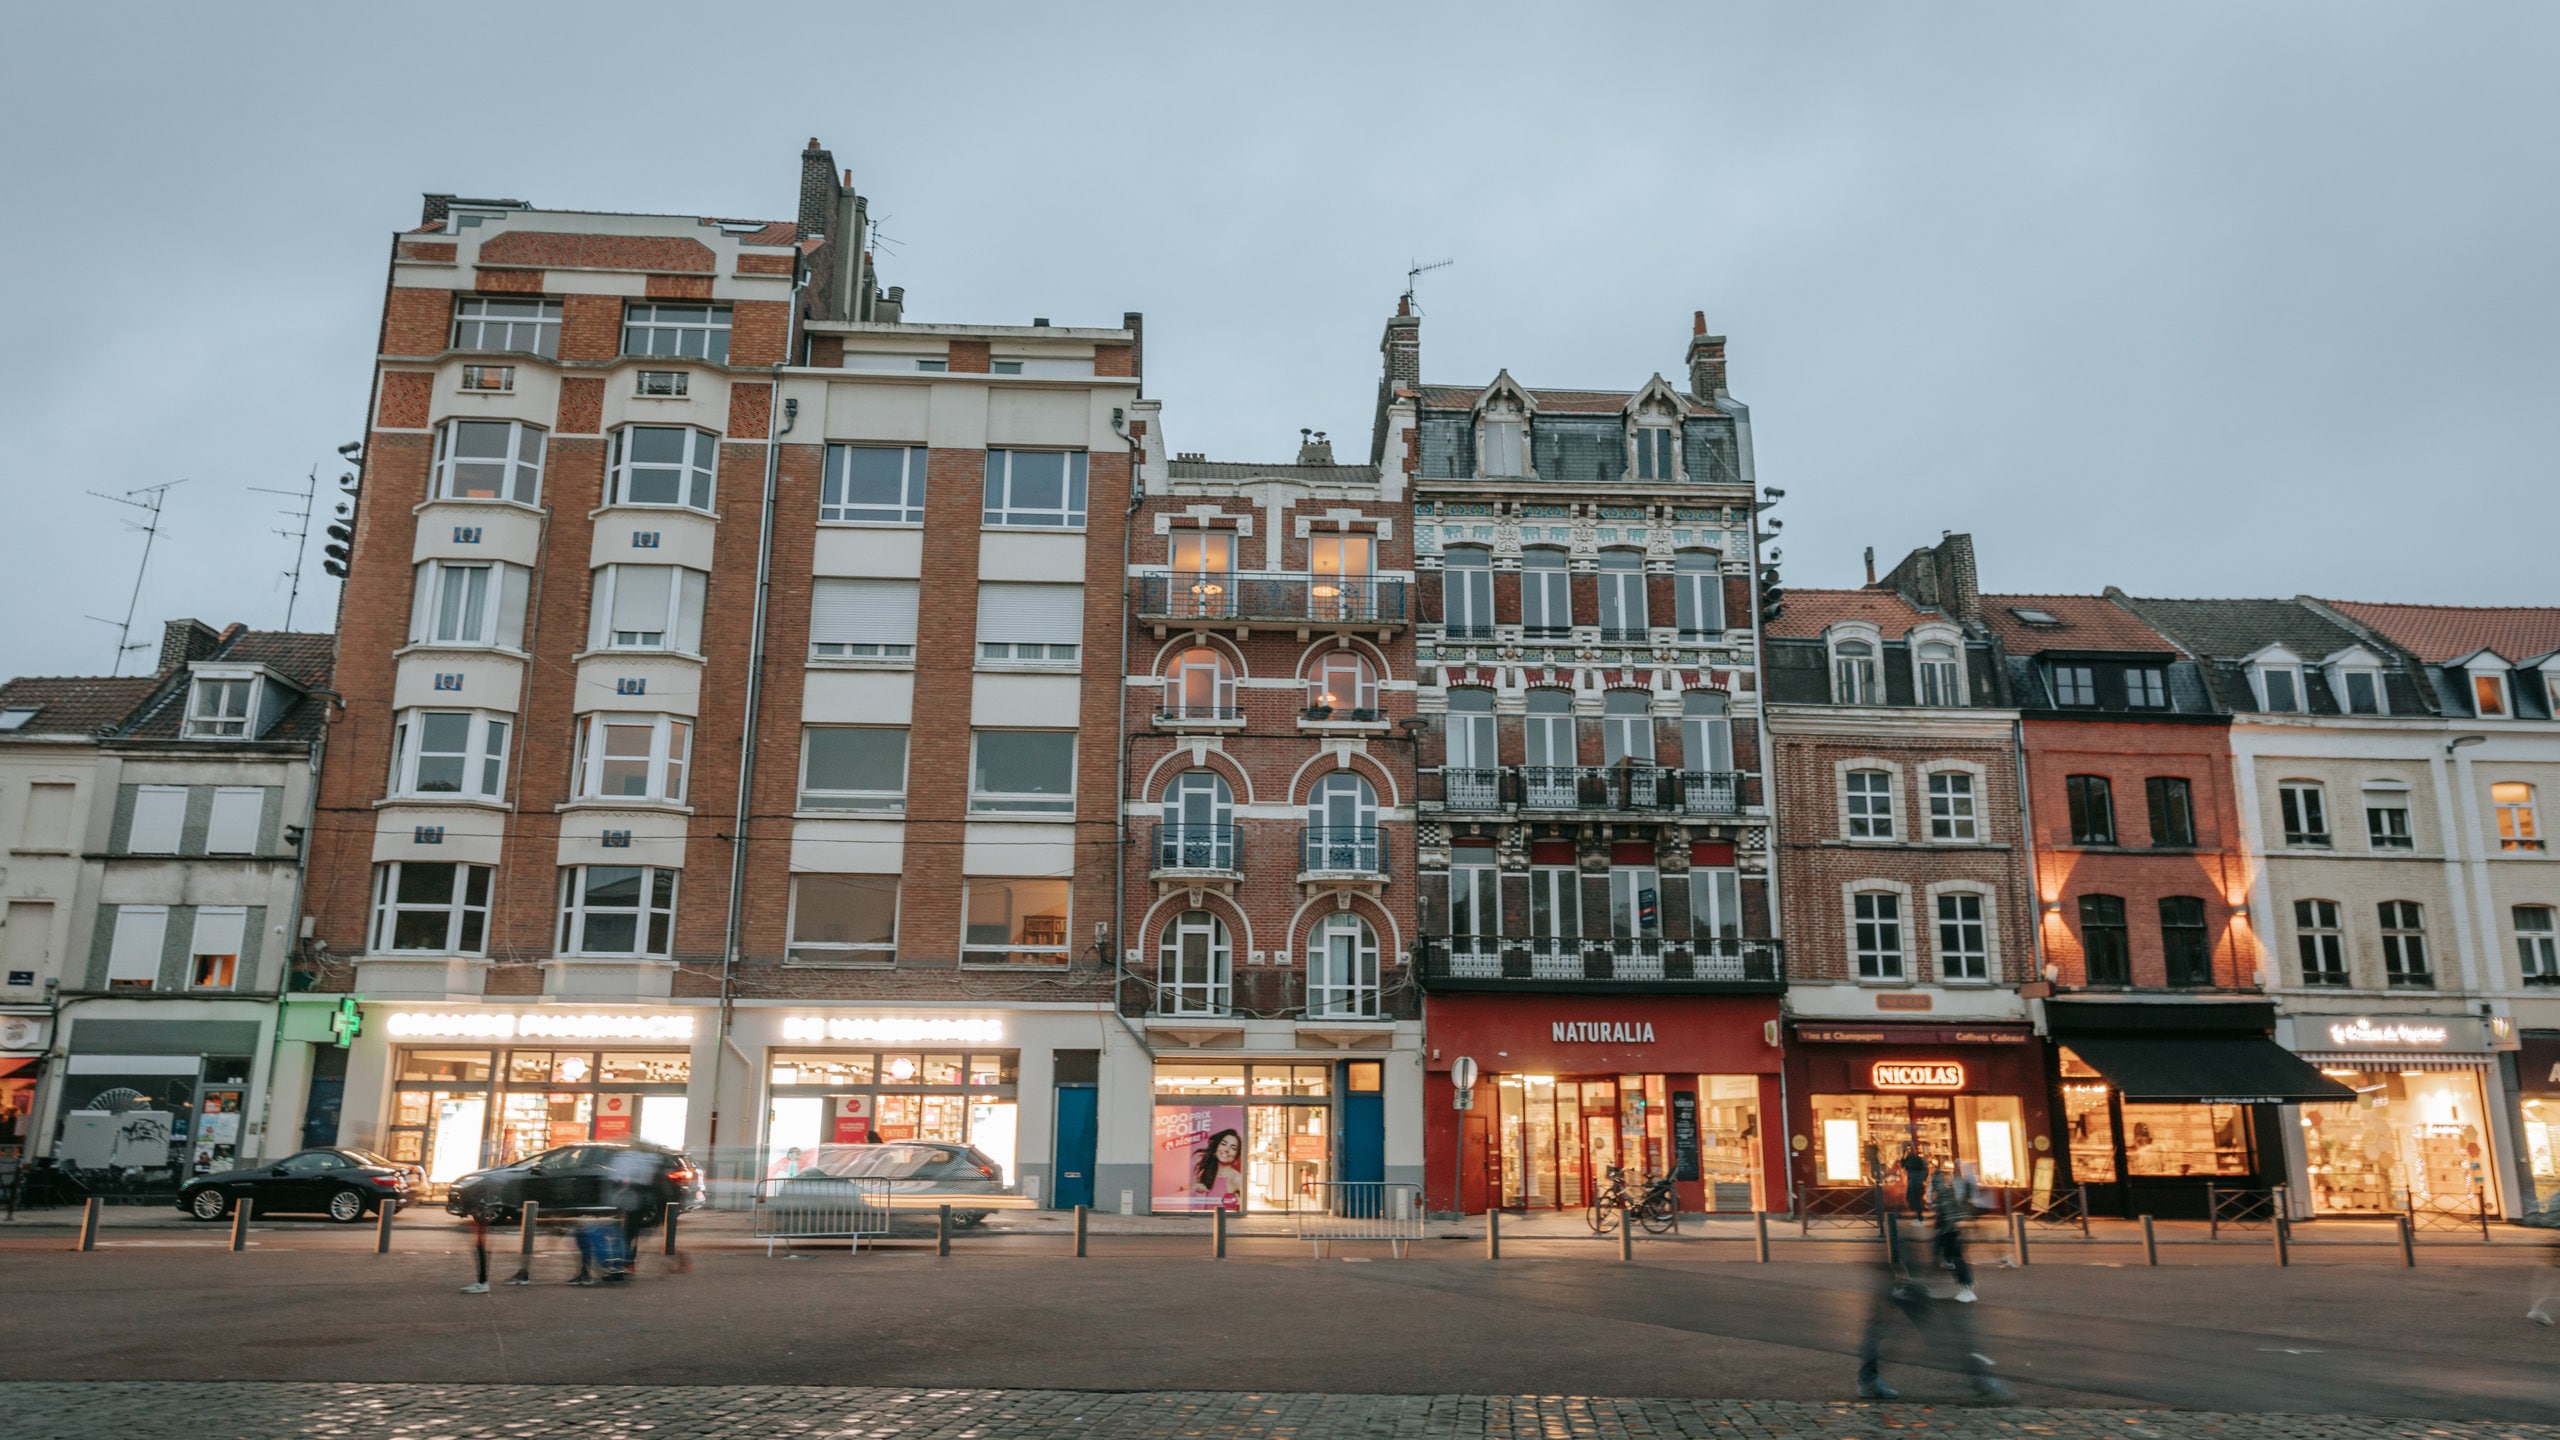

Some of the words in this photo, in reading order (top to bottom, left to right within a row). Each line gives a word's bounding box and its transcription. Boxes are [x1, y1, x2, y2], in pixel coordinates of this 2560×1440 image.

[1552, 1022, 1655, 1042] NATURALIA
[1878, 1066, 1958, 1084] NICOLAS
[1155, 1113, 1188, 1126] 1000
[1189, 1111, 1211, 1121] PRIX
[1166, 1119, 1212, 1138] FOLIE
